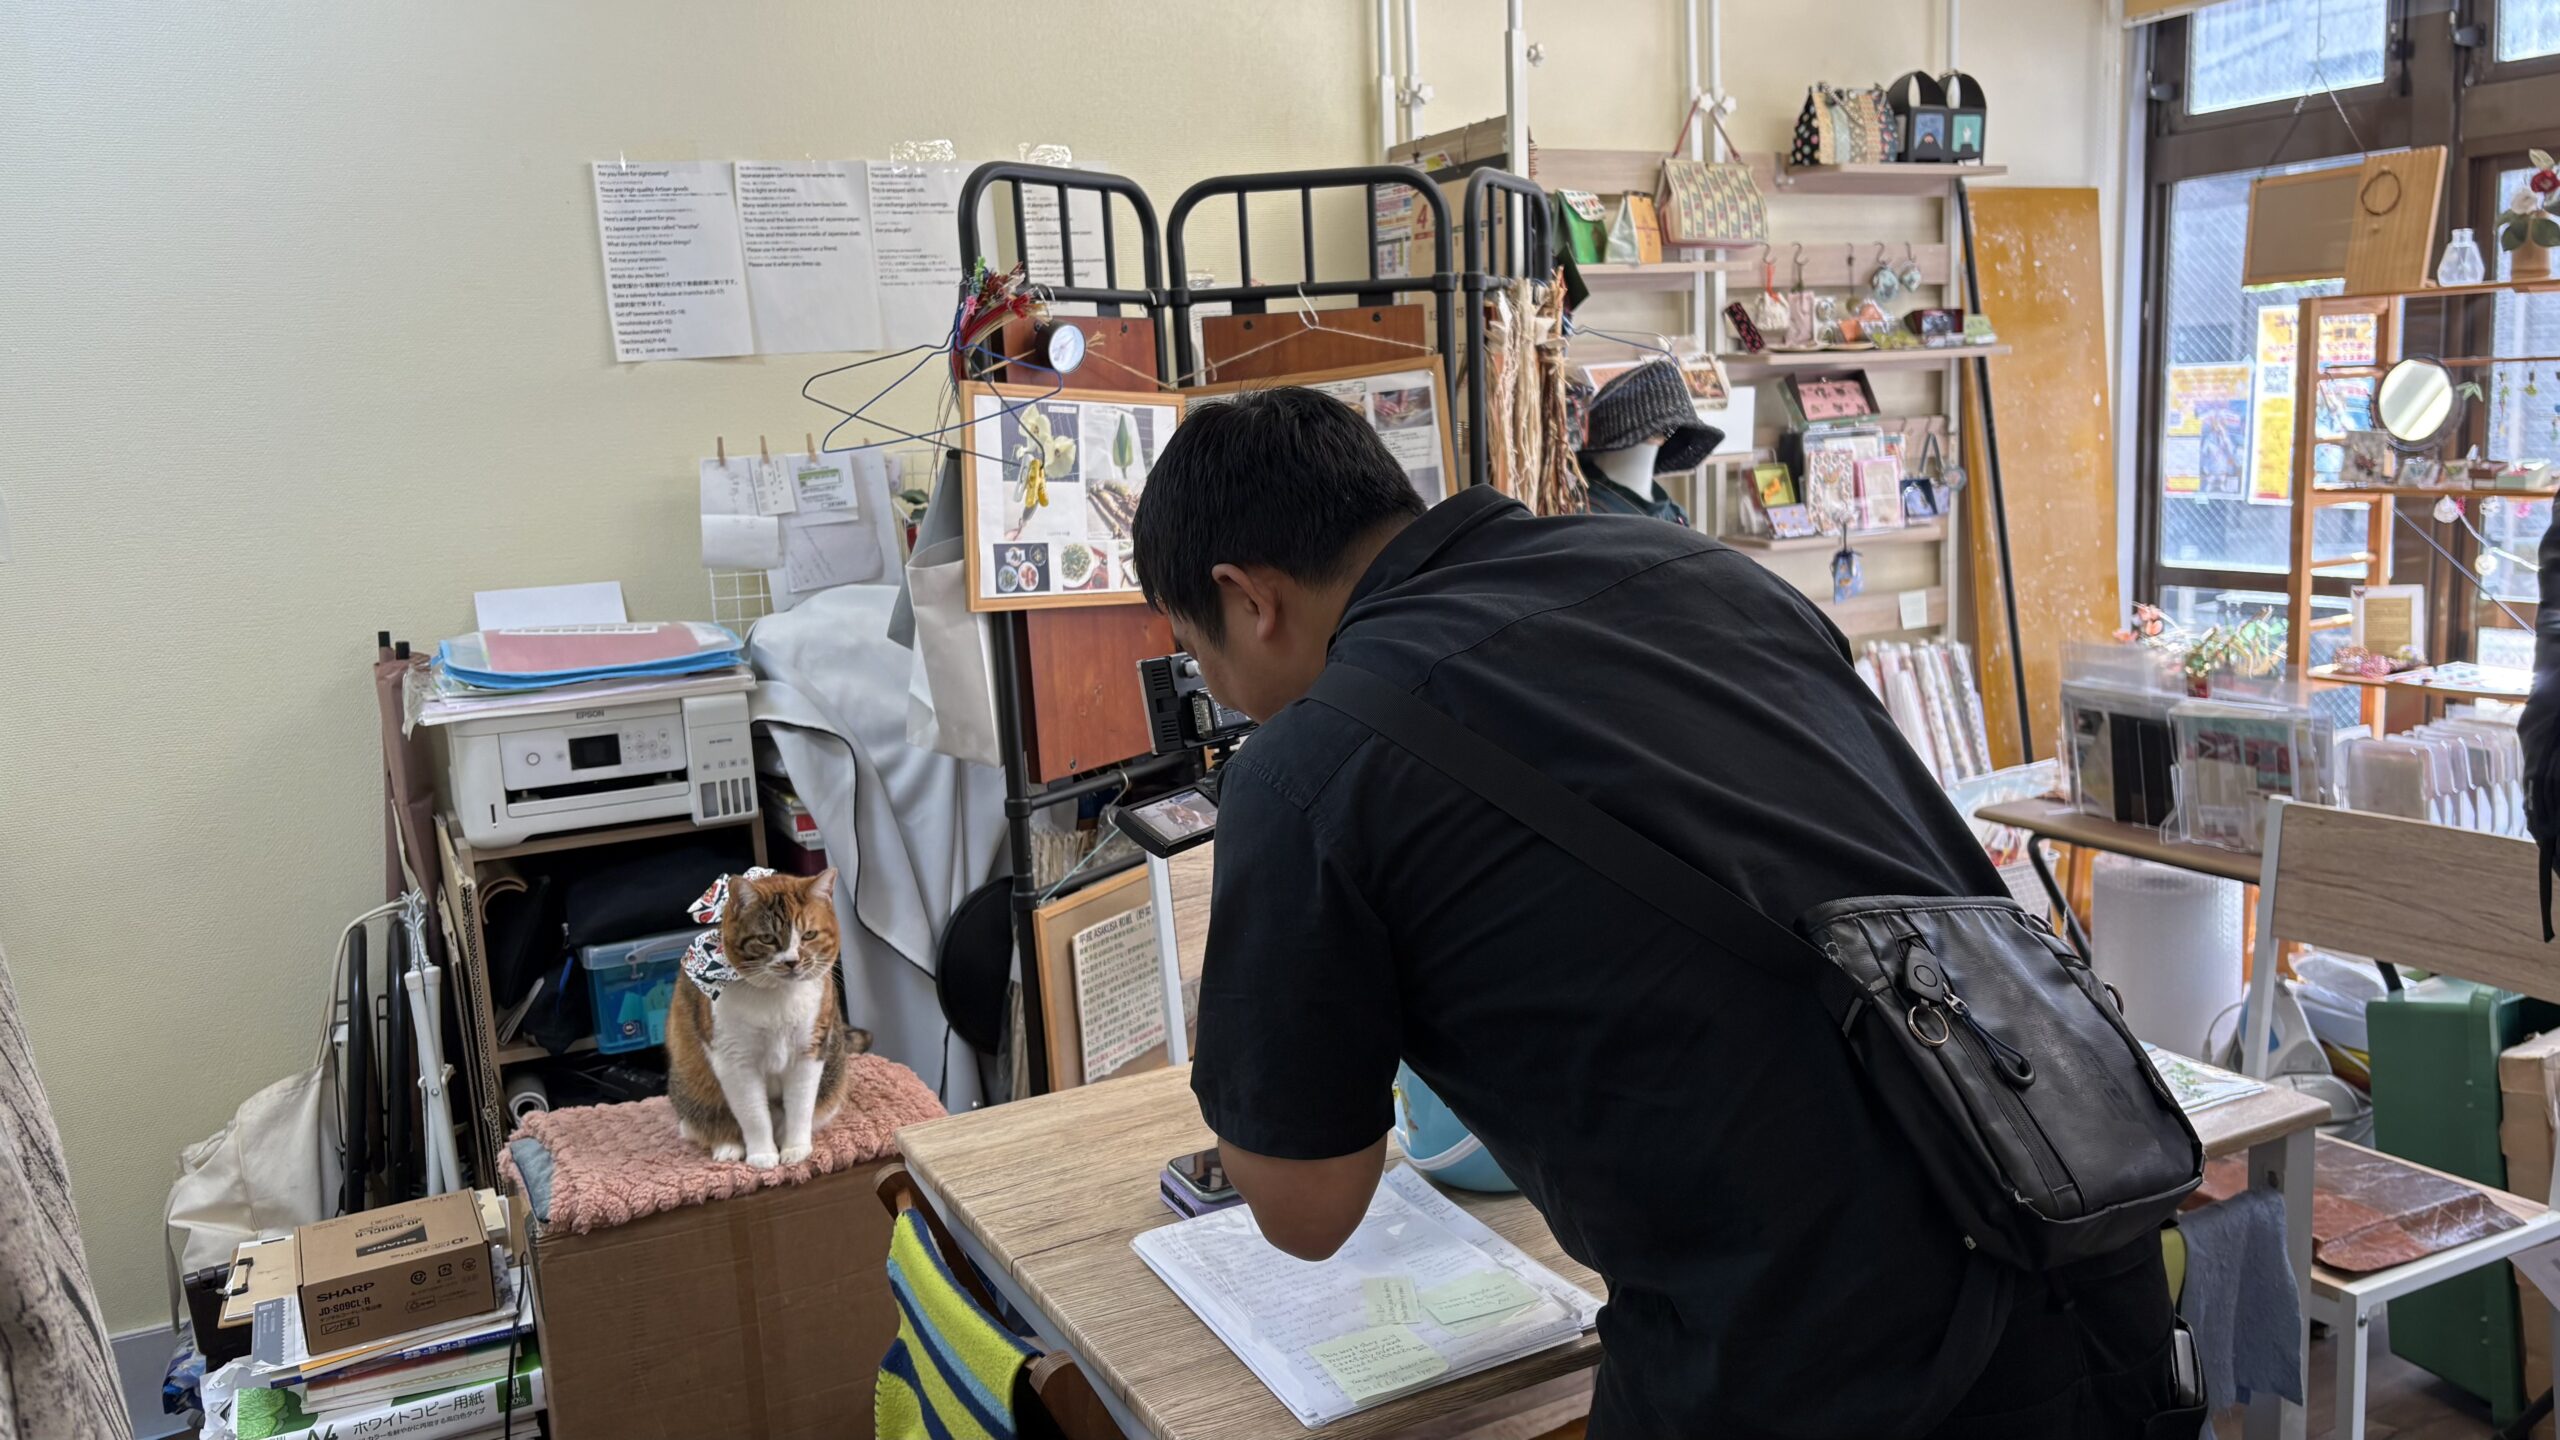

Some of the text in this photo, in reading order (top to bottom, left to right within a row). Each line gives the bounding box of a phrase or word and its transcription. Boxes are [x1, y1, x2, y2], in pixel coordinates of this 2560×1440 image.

[1417, 203, 1429, 230] 4
[576, 710, 605, 720] EPSON
[1095, 921, 1118, 938] ASAKUSA
[367, 1237, 417, 1252] SHARP
[316, 1282, 375, 1302] SHARP
[353, 1389, 486, 1436] ホワイトコピー用紙
